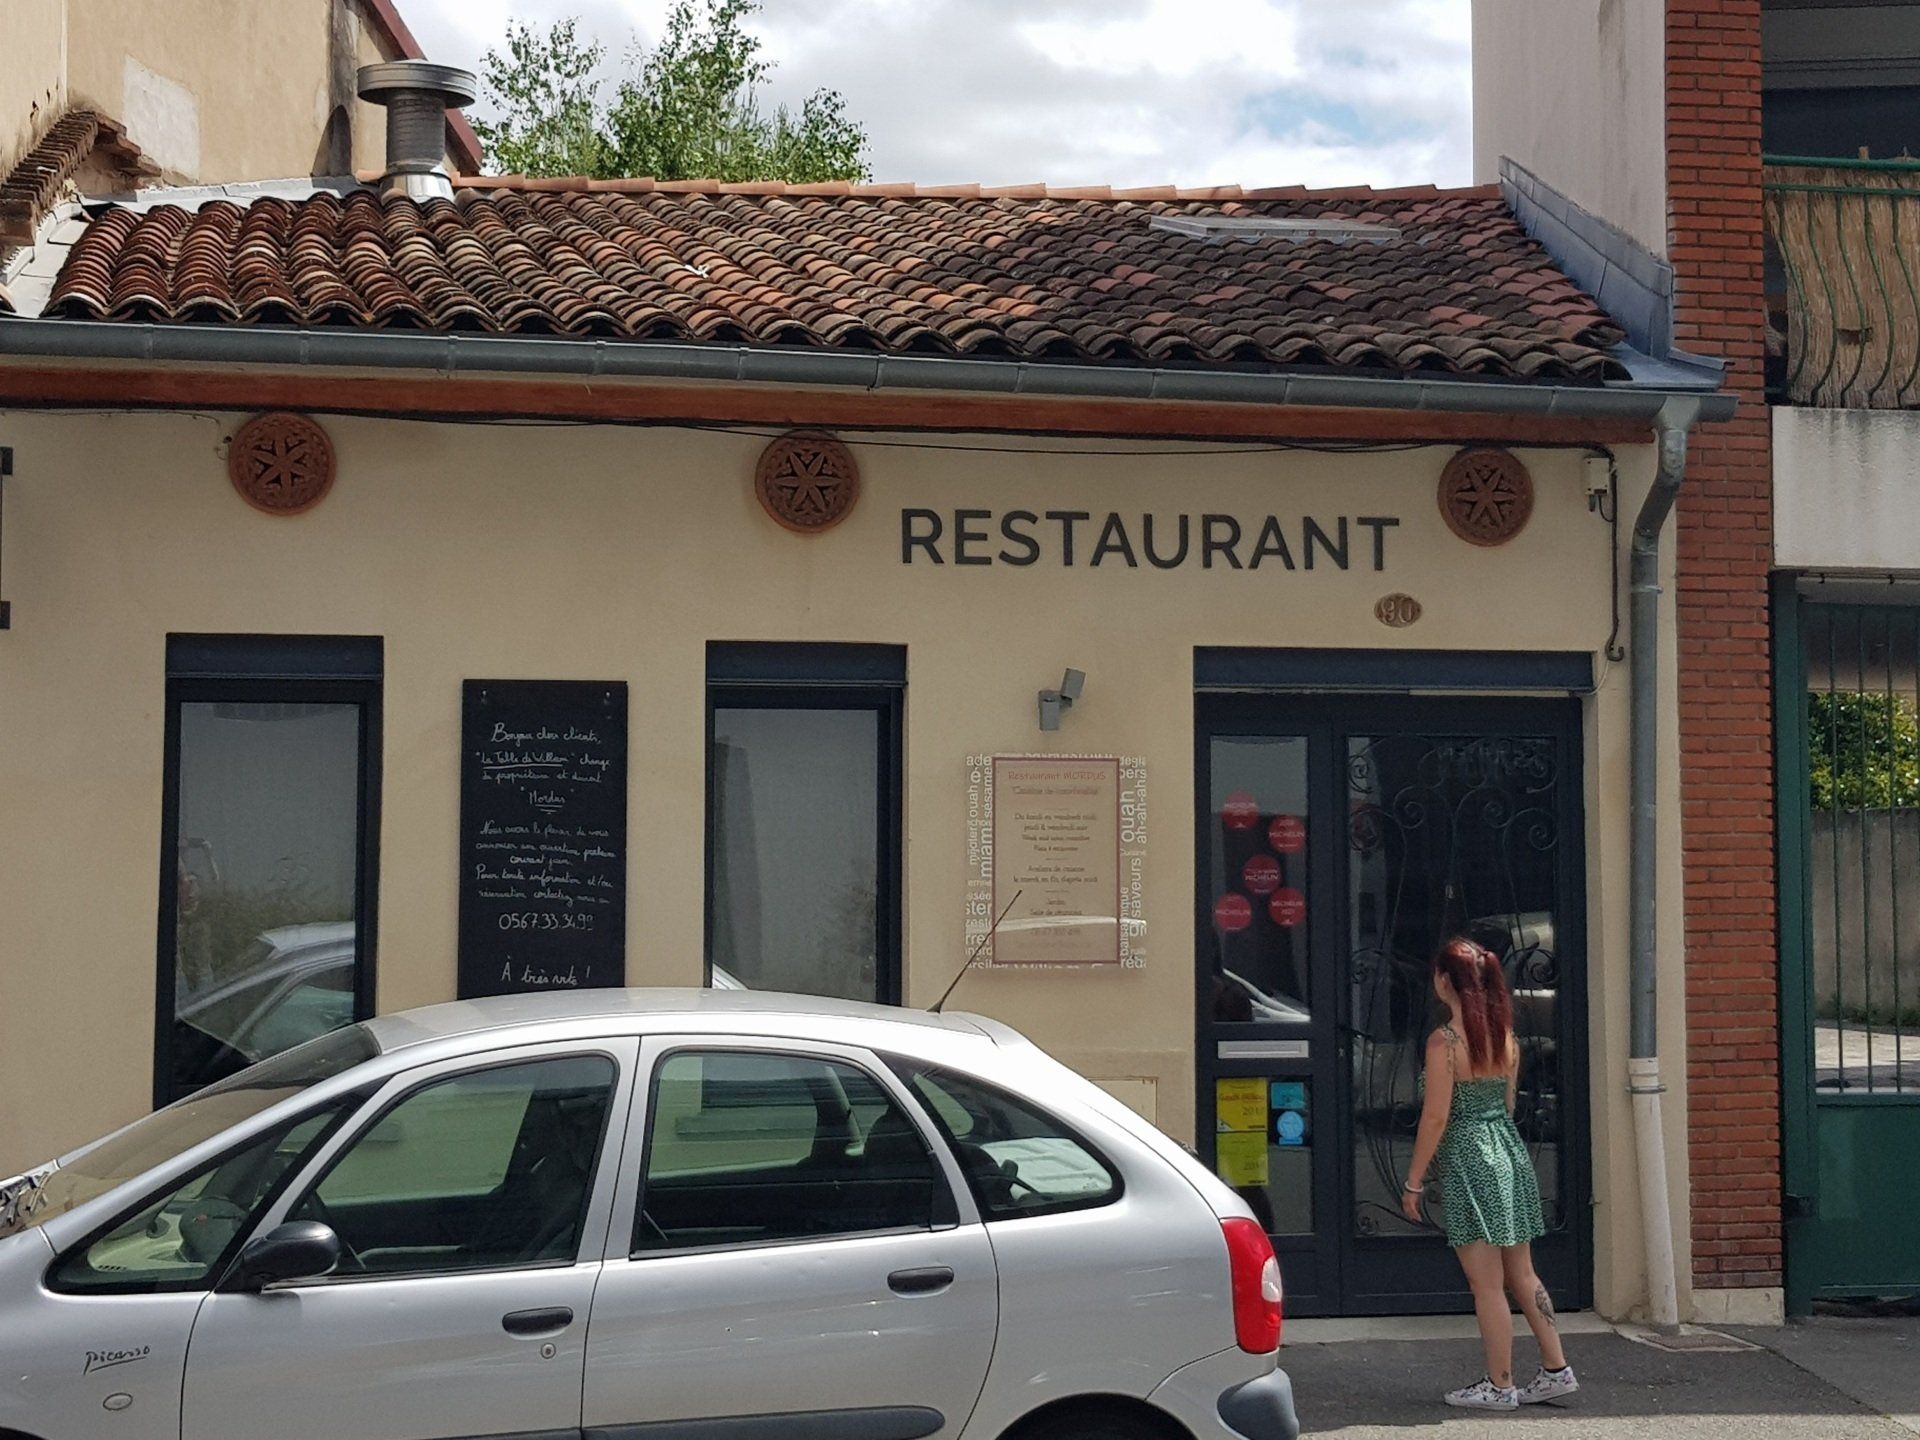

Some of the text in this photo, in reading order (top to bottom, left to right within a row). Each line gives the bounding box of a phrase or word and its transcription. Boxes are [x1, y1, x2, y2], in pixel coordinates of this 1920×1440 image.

[901, 508, 1400, 571] RESTAURANT
[967, 784, 979, 818] ouah
[1121, 790, 1135, 842] ouah
[1131, 858, 1142, 918] saveurs
